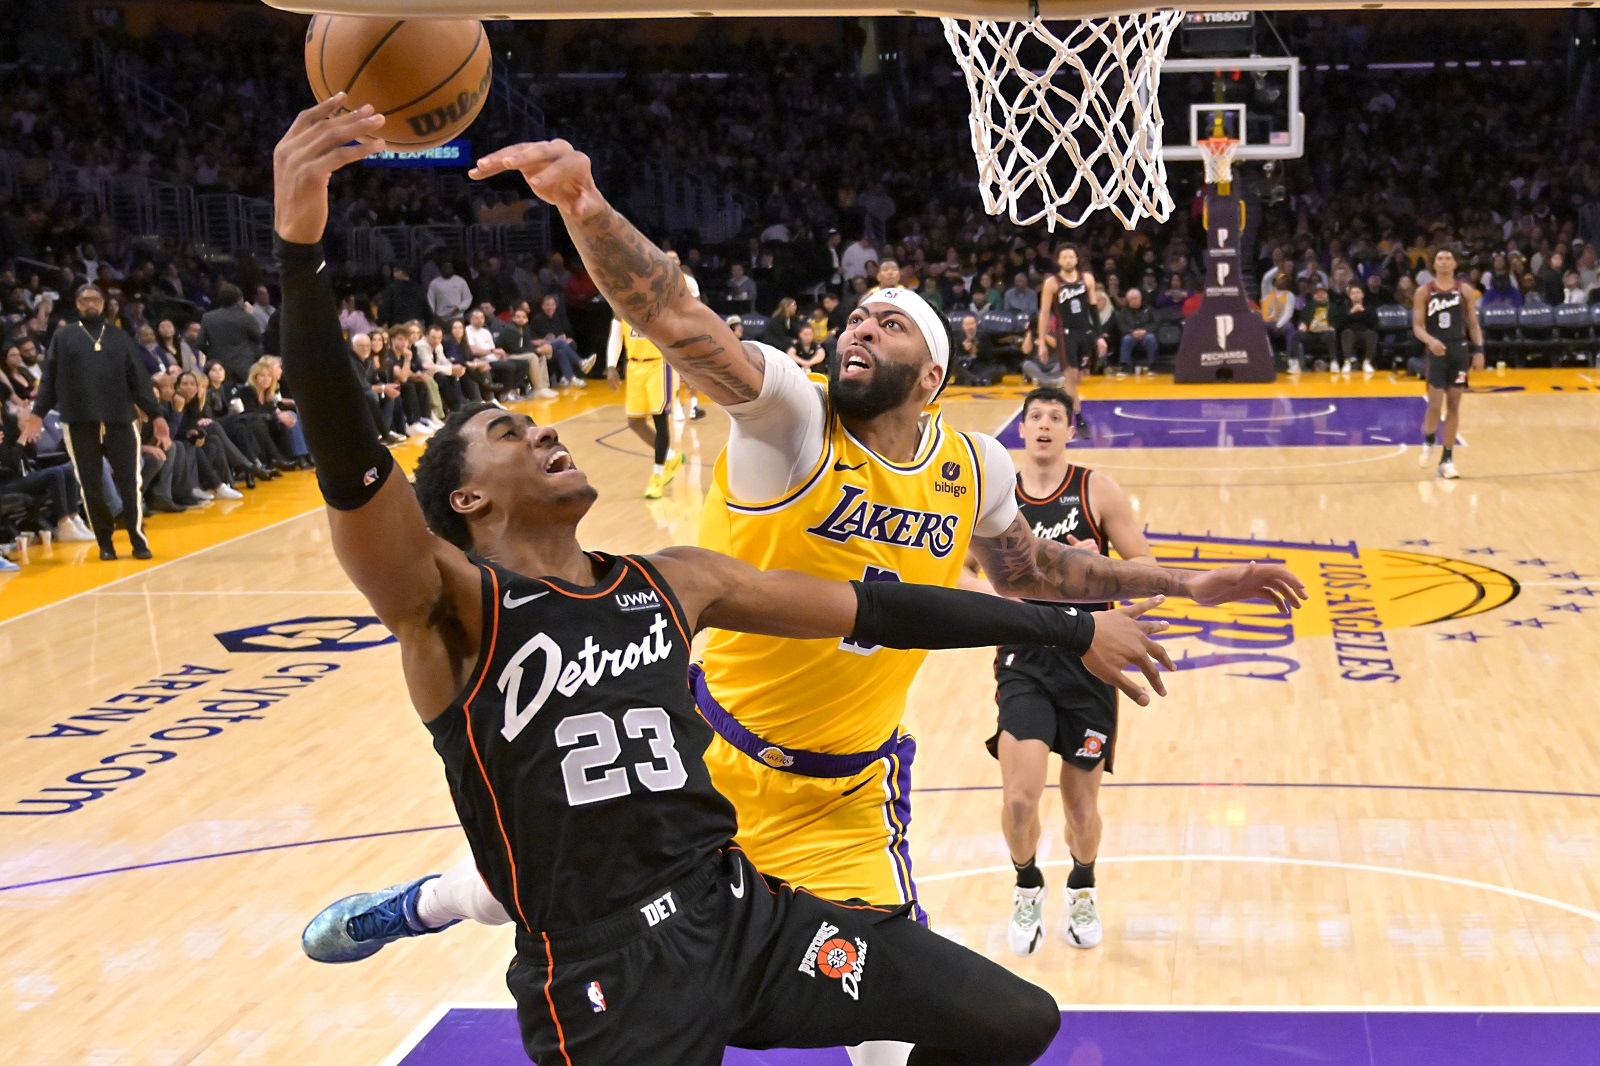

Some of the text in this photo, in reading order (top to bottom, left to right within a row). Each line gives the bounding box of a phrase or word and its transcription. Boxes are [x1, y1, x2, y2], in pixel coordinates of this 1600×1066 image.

[1204, 12, 1249, 22] TISSOT
[1200, 350, 1248, 361] PECHANGA
[934, 481, 967, 498] bibigo
[805, 484, 960, 559] LAKERS
[1032, 507, 1079, 540] troit
[615, 590, 659, 607] UWM
[1319, 562, 1401, 684] LOS ANGELES
[26, 664, 234, 739] ARENA
[497, 612, 673, 743] Detroit
[0, 662, 342, 816] crypto.com
[554, 707, 689, 807] 23
[640, 891, 677, 927] DET
[797, 921, 840, 978] PISTONS
[841, 936, 868, 1001] Detroit
